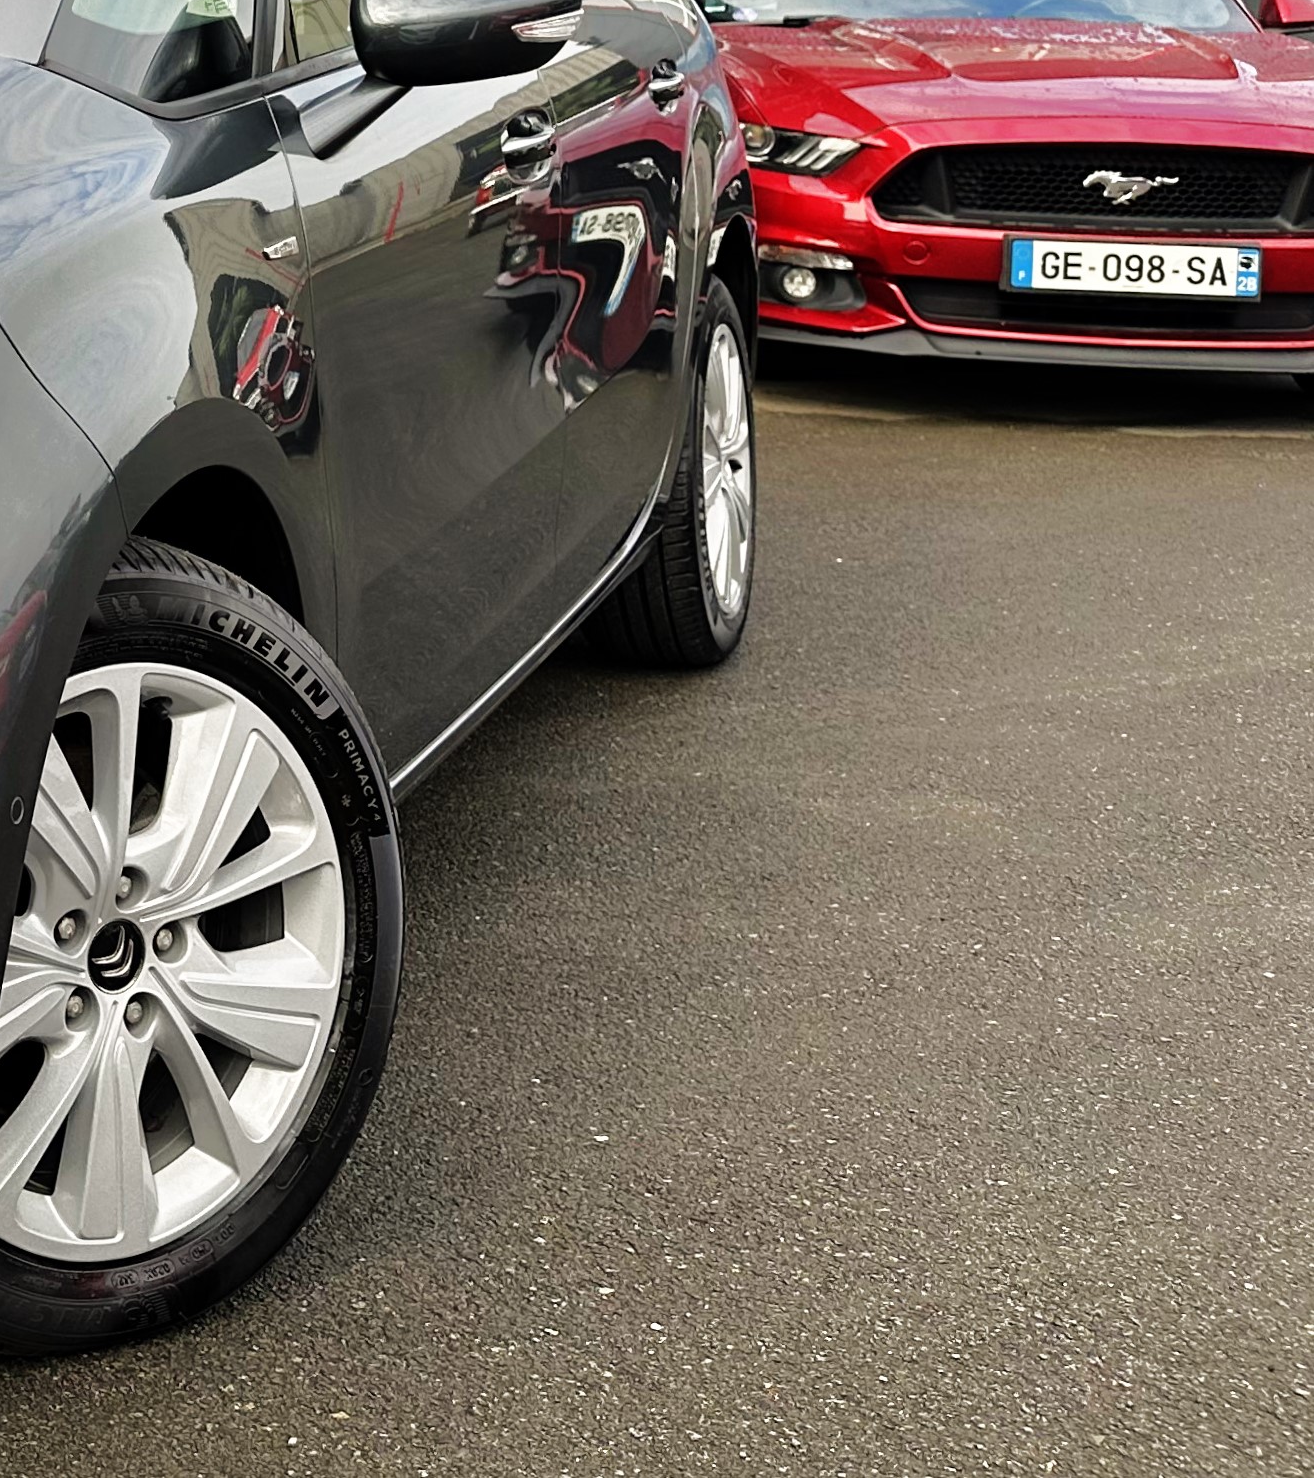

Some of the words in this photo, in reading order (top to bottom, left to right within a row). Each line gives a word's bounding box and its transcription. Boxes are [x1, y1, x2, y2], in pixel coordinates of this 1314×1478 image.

[1237, 276, 1258, 292] 2B
[155, 595, 331, 710] MICHELIN
[338, 728, 380, 810] PRIMACY
